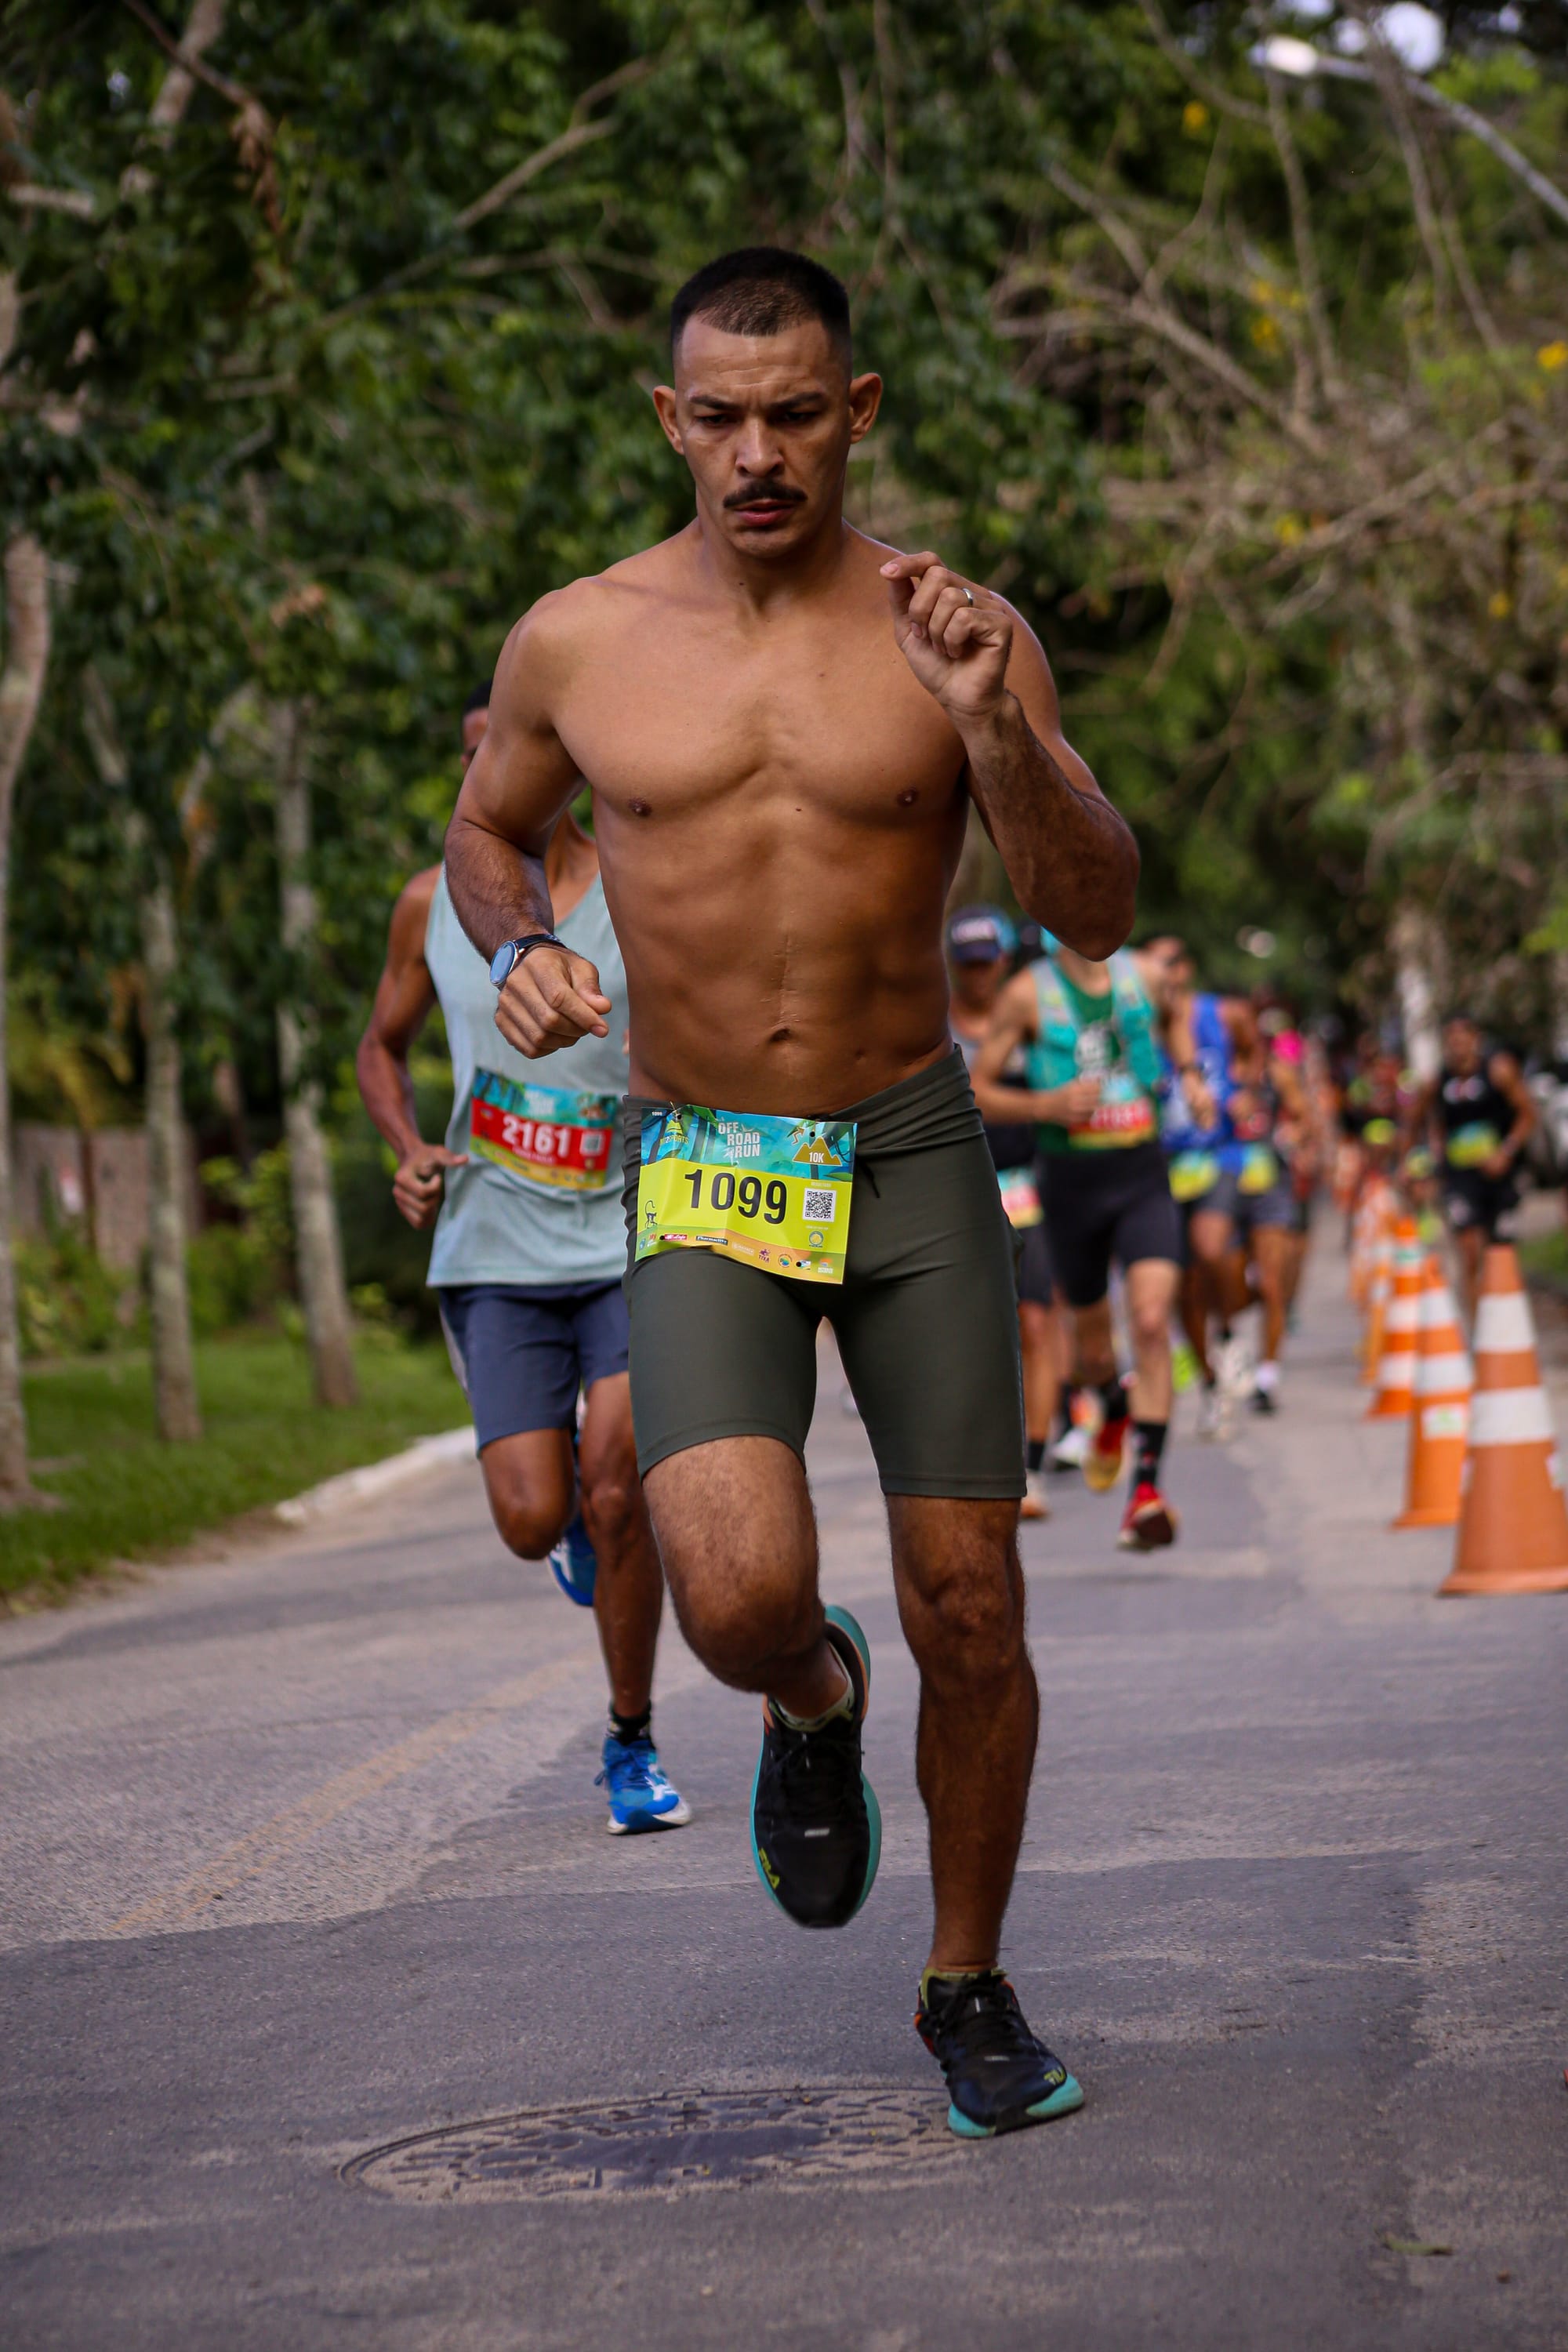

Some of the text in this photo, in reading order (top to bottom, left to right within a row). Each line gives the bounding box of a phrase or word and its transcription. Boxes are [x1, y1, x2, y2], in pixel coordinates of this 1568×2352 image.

[718, 1123, 739, 1134] OFF
[503, 1115, 571, 1158] 2161
[728, 1132, 760, 1145] ROAD
[735, 1144, 760, 1158] RUN
[809, 1152, 825, 1163] 10K
[684, 1169, 787, 1225] 1099
